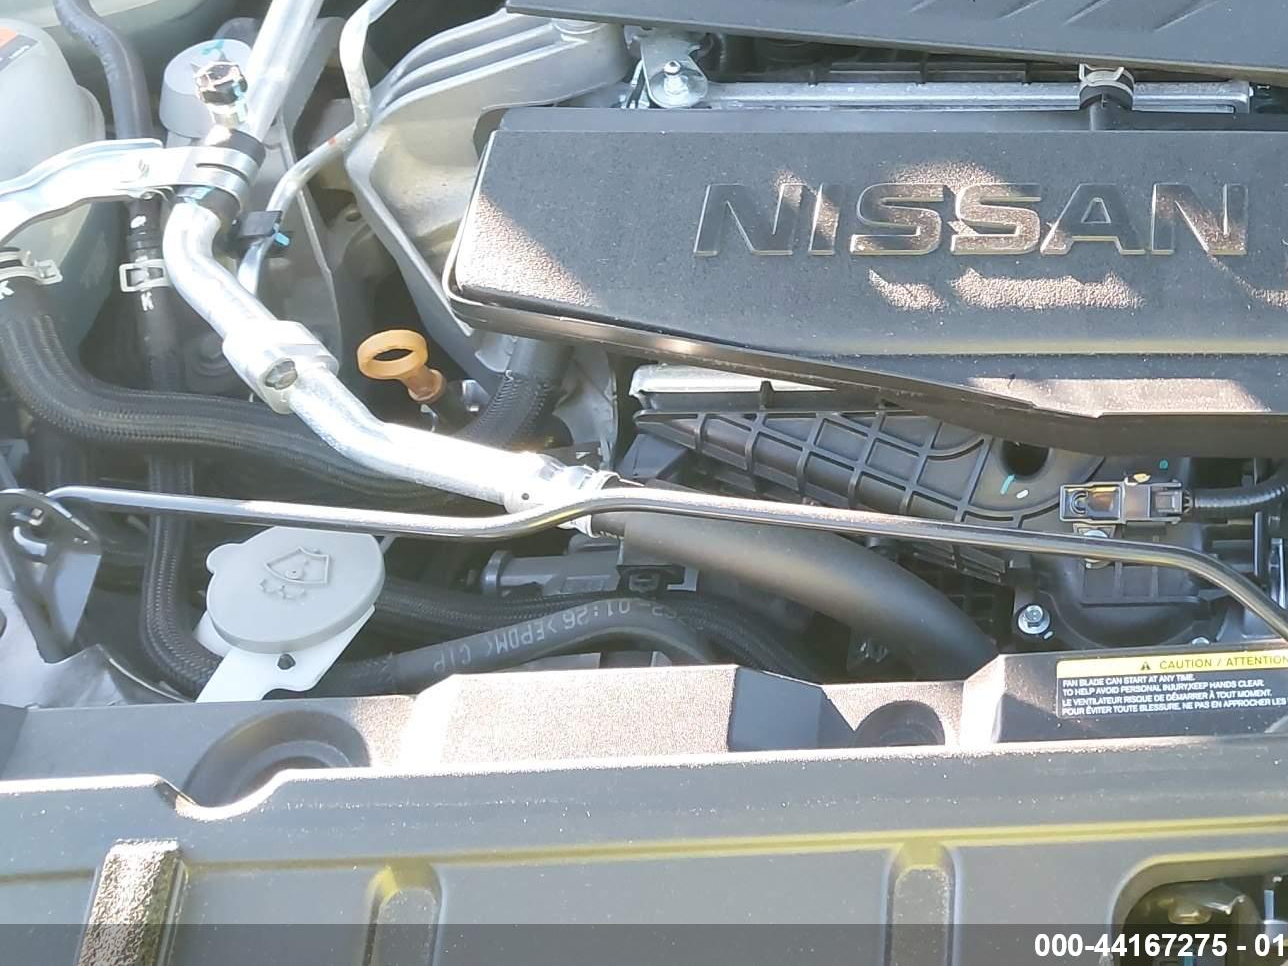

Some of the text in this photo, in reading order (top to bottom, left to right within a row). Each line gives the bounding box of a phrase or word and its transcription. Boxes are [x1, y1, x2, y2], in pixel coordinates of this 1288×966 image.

[693, 182, 1248, 256] NISSAN
[1160, 658, 1212, 670] CAUTION
[1062, 689, 1073, 697] TO
[1075, 687, 1095, 696] HELP
[1096, 686, 1119, 695] AVOID
[1121, 684, 1161, 693] PERSONAL
[1209, 680, 1237, 689] HANDS
[1063, 673, 1195, 688] FAN BLADE CAN START AT ANY TIME.
[1061, 707, 1085, 716] POUR
[1086, 705, 1112, 714] ÉVITER
[1113, 704, 1138, 713] TOUTE
[1182, 702, 1193, 710] NE
[1194, 701, 1210, 709] PAS
[1211, 700, 1222, 709] EN
[1223, 698, 1271, 708] APPROCHER
[1272, 697, 1286, 705] LES
[1062, 698, 1072, 707] LE
[1072, 696, 1122, 706] VENTILATEUR
[1124, 695, 1152, 704] RISQUE
[1154, 694, 1165, 702] DE
[1165, 691, 1208, 702] DÉMARRER
[1216, 690, 1236, 699] TOUT
